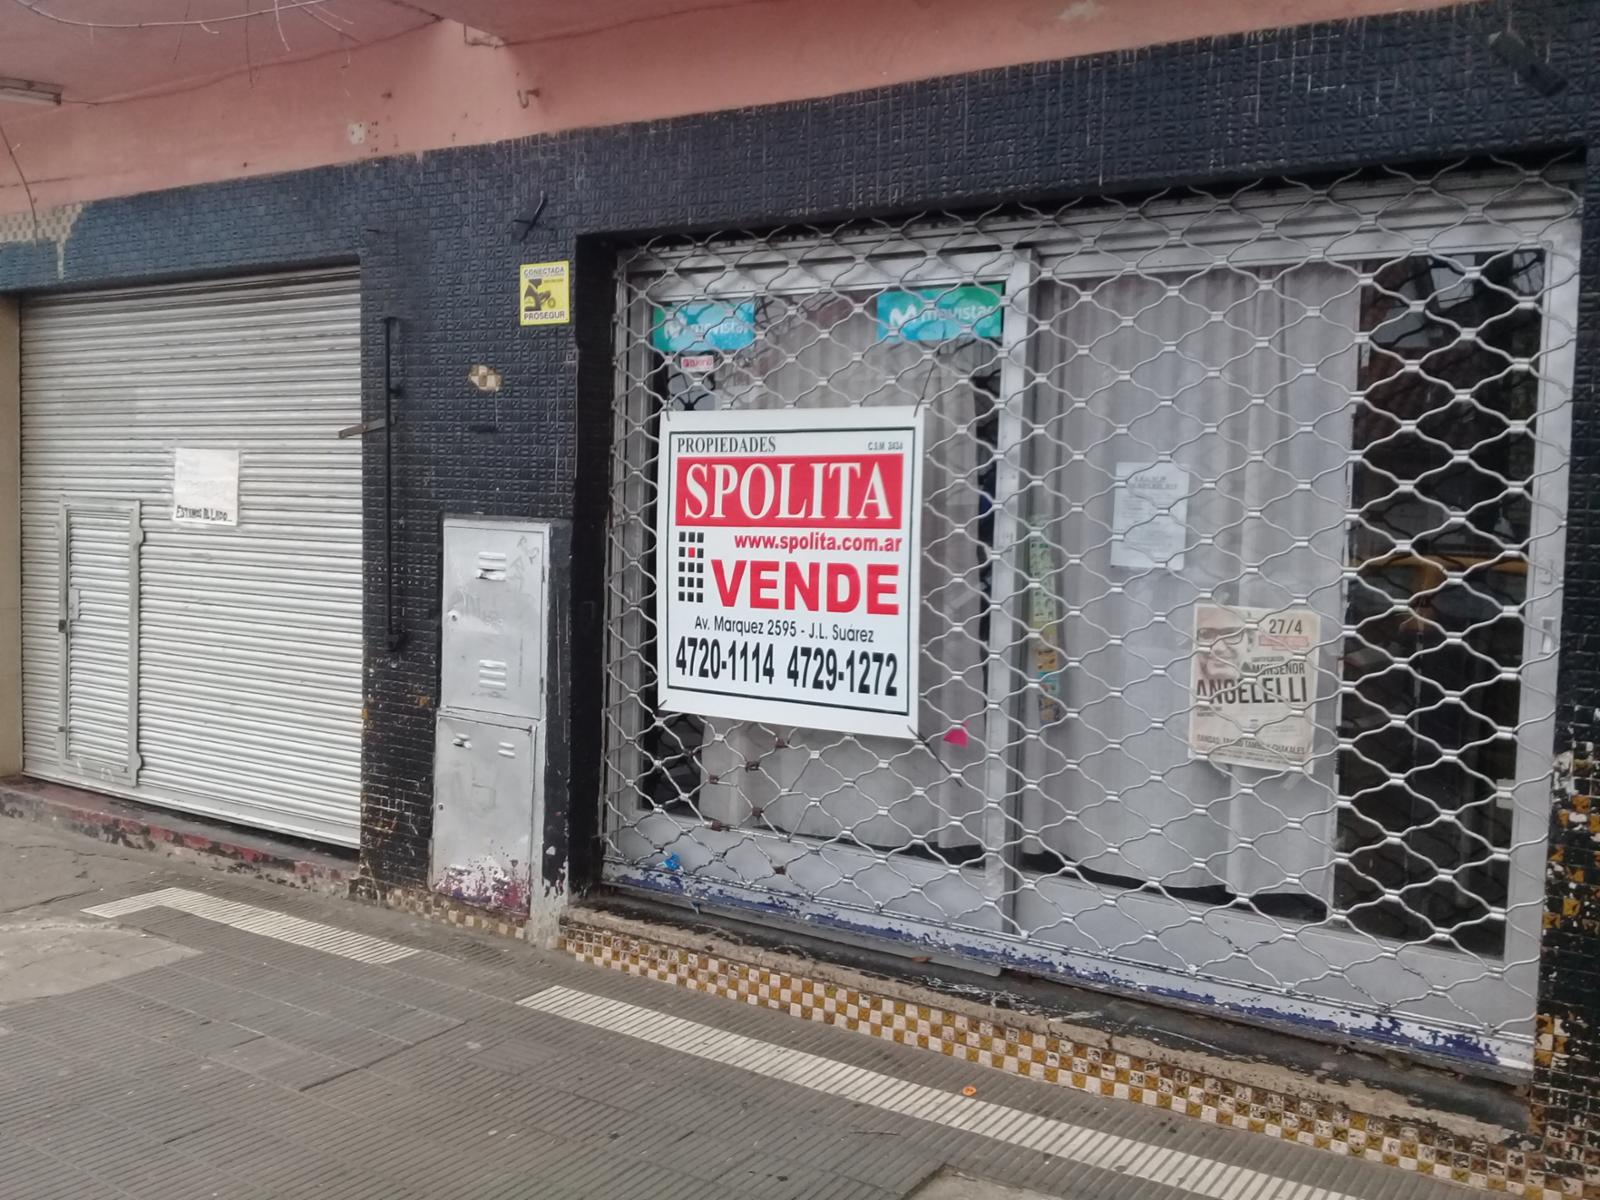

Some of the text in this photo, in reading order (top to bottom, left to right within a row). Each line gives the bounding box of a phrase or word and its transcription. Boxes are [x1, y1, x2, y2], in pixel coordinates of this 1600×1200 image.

[524, 267, 564, 276] CONECTADA
[524, 310, 565, 320] PROSEGUR
[677, 436, 776, 453] PROPIEDADES
[684, 461, 893, 520] SPOLITA
[734, 532, 903, 553] www.spolita.com.ar
[711, 559, 899, 615] VENDE
[694, 616, 710, 630] Av.
[714, 616, 764, 637] Marquez
[767, 620, 797, 637] 2595
[808, 623, 828, 640] J.L.
[832, 624, 875, 643] Suárez
[1268, 618, 1303, 635] 27/4
[675, 636, 898, 697] 4720-1114 4729-1272
[1196, 677, 1308, 705] ANGELELLI
